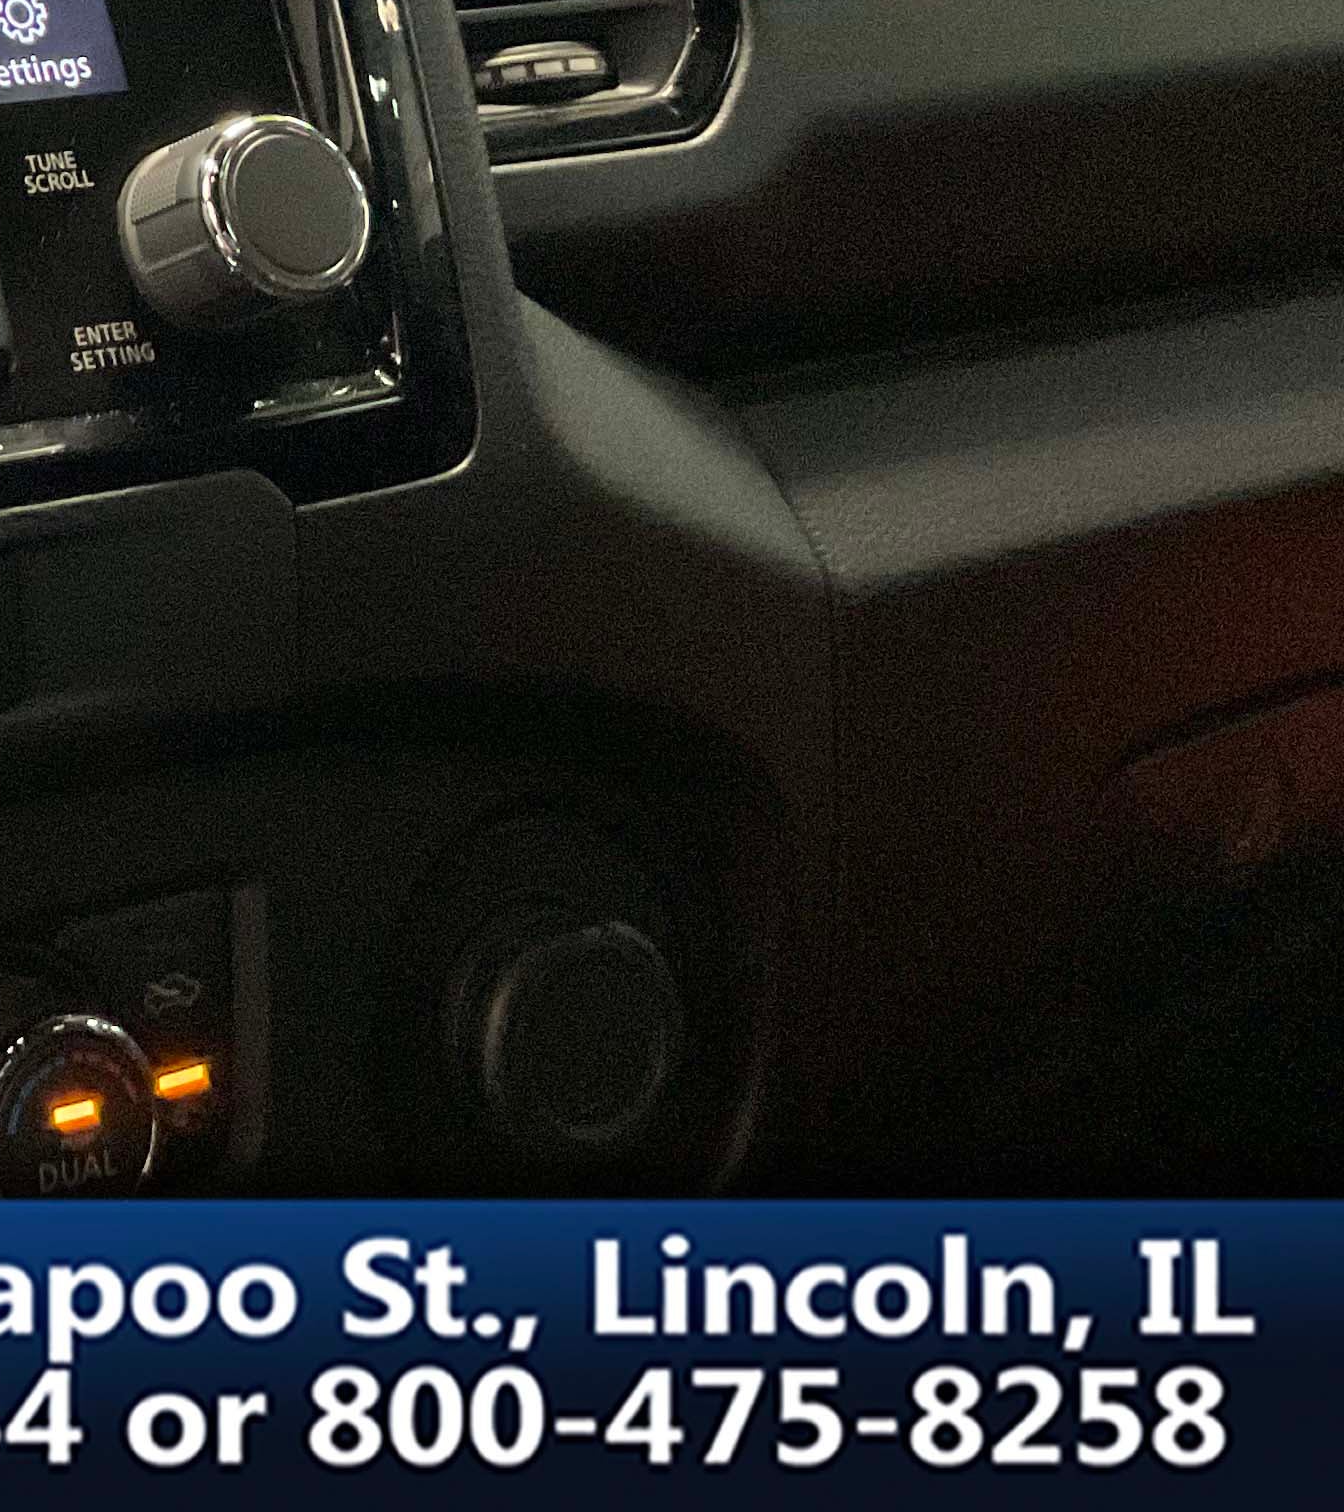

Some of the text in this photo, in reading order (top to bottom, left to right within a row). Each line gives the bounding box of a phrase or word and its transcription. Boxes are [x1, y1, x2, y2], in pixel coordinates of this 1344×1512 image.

[24, 150, 78, 172] TUNE
[23, 168, 95, 195] SCROLL
[73, 320, 137, 349] ENTER
[69, 342, 156, 374] SETTING
[39, 1149, 116, 1193] DUAL
